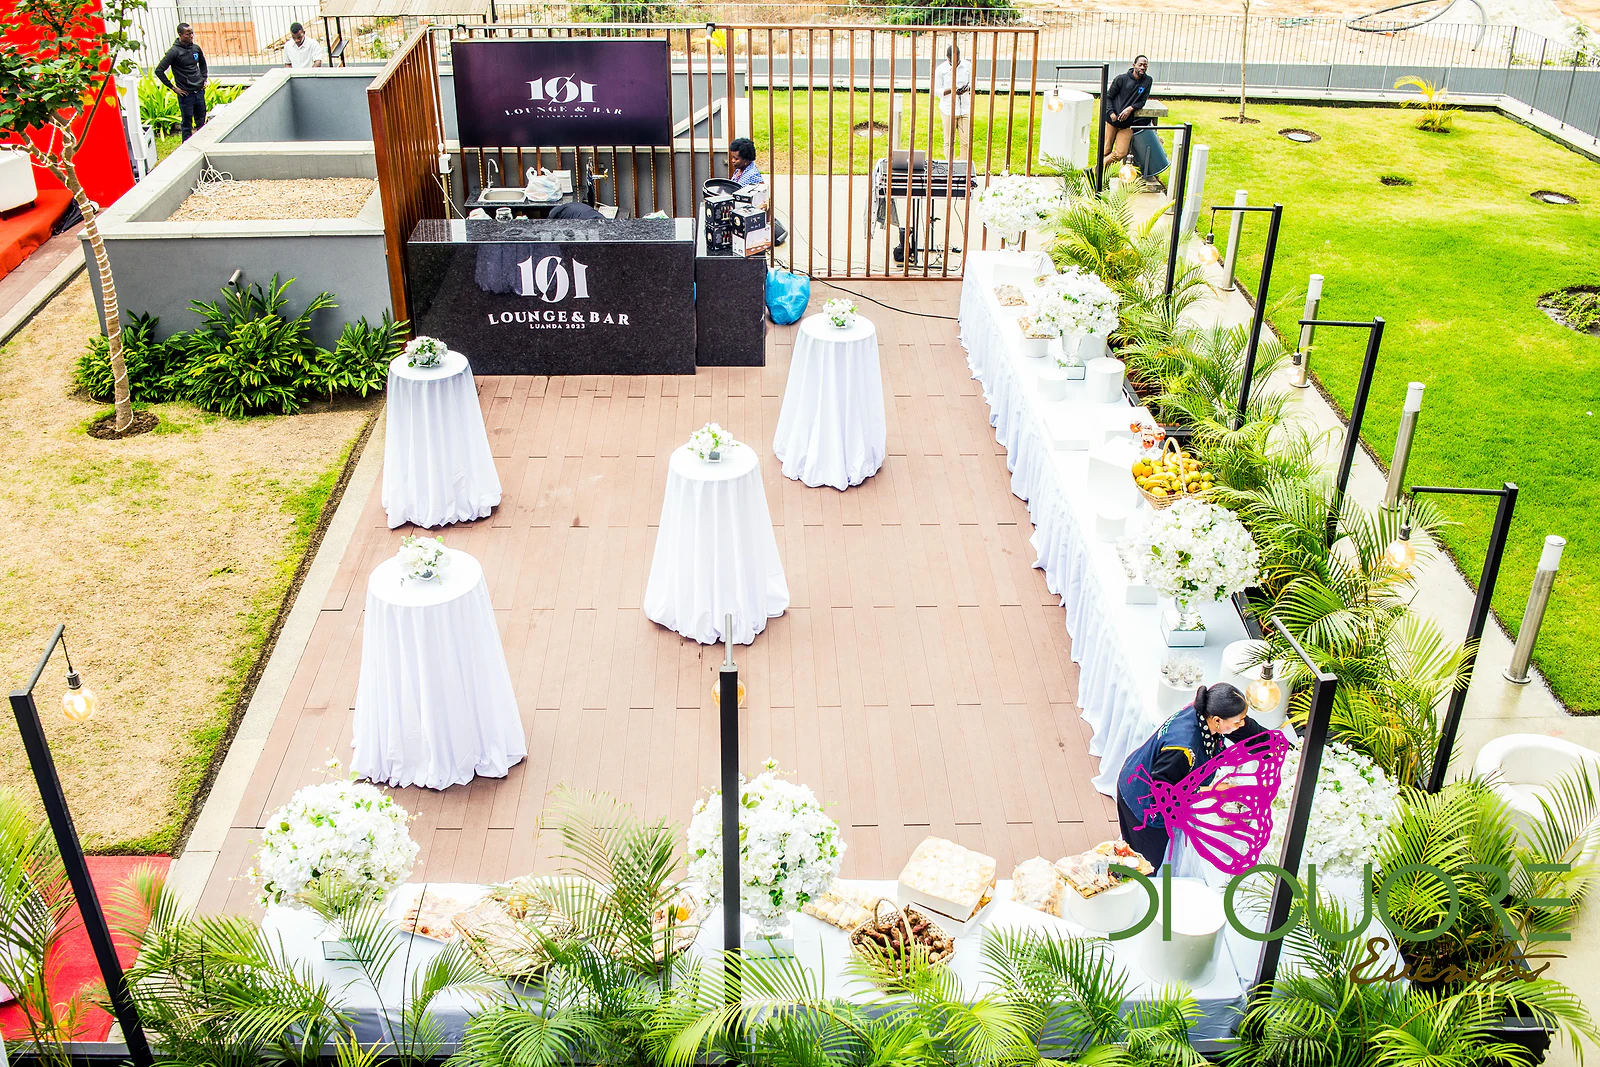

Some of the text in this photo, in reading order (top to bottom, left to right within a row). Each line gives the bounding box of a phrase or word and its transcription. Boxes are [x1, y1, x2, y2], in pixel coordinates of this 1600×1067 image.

[504, 106, 568, 116] LOUNGE
[592, 106, 622, 115] BAR
[488, 310, 568, 325] LOUNGE
[589, 311, 630, 326] BAR
